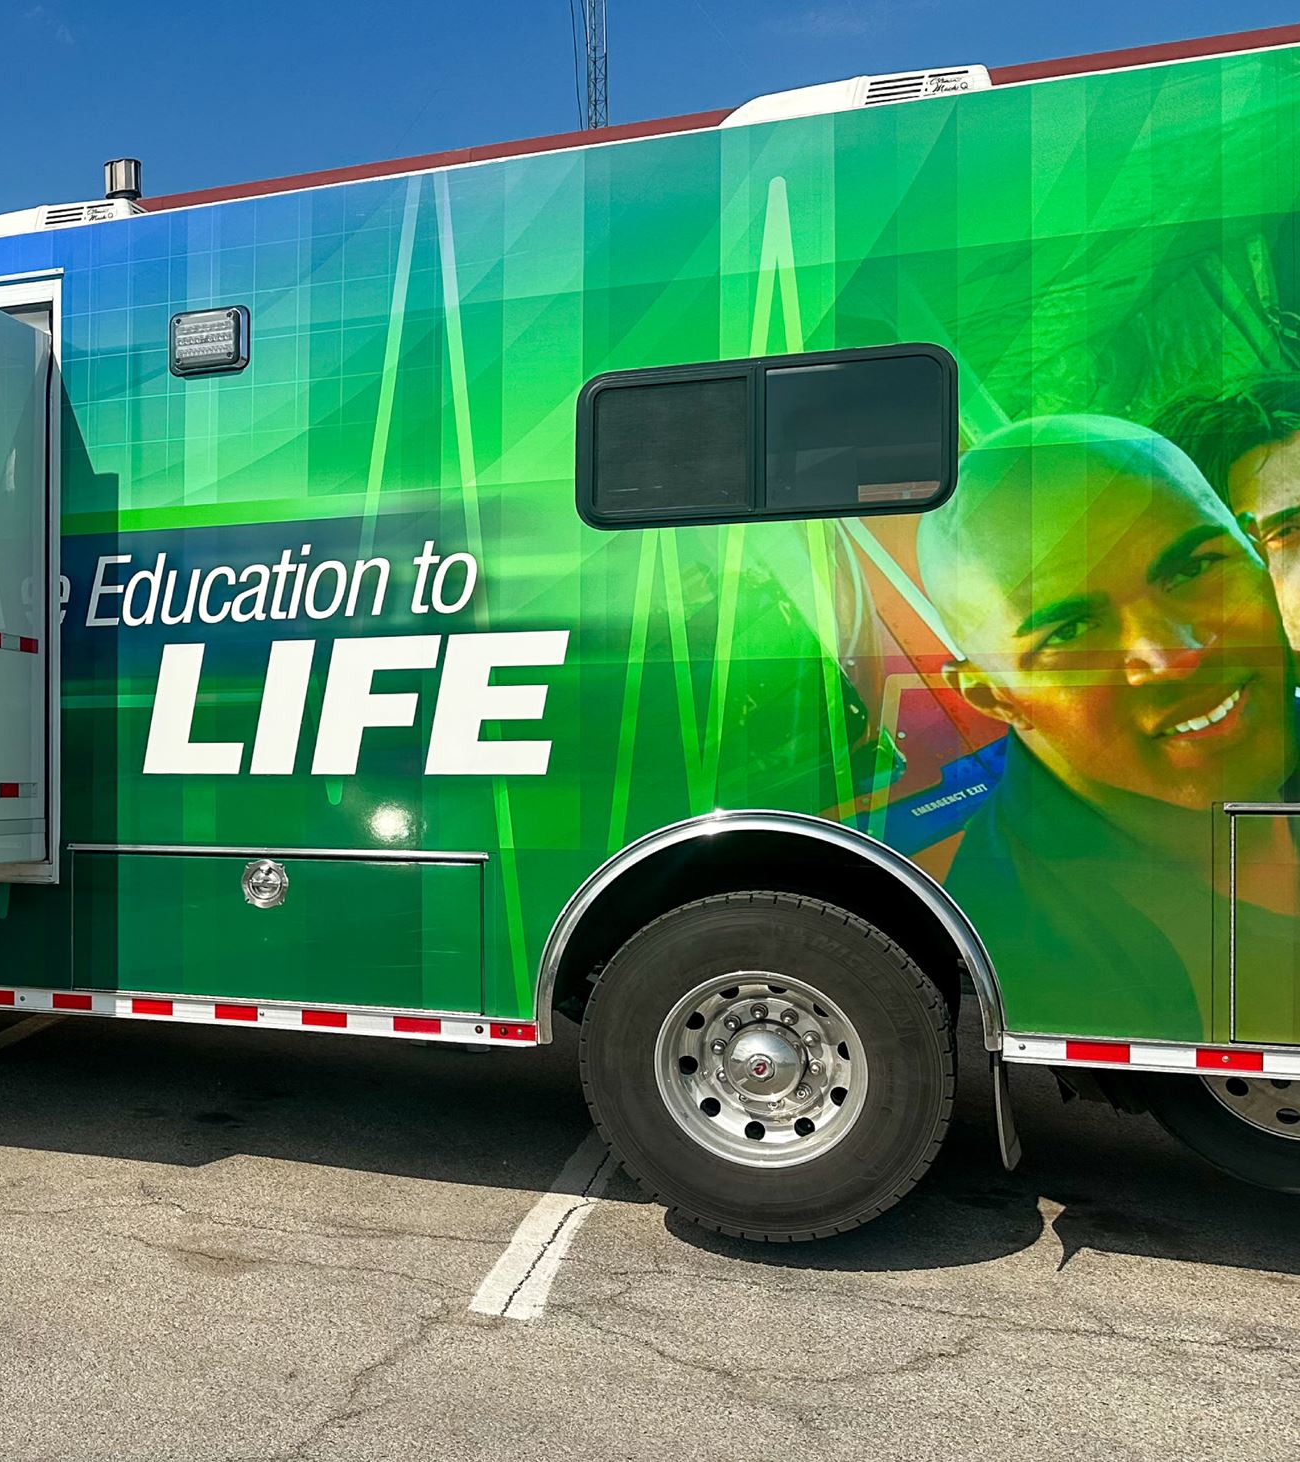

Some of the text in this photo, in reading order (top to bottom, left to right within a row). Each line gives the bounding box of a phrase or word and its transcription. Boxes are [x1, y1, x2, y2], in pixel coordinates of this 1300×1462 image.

[85, 543, 391, 628] Education
[410, 535, 478, 615] to
[142, 630, 571, 776] LIFE
[911, 783, 989, 817] EMERGENCY EXIT
